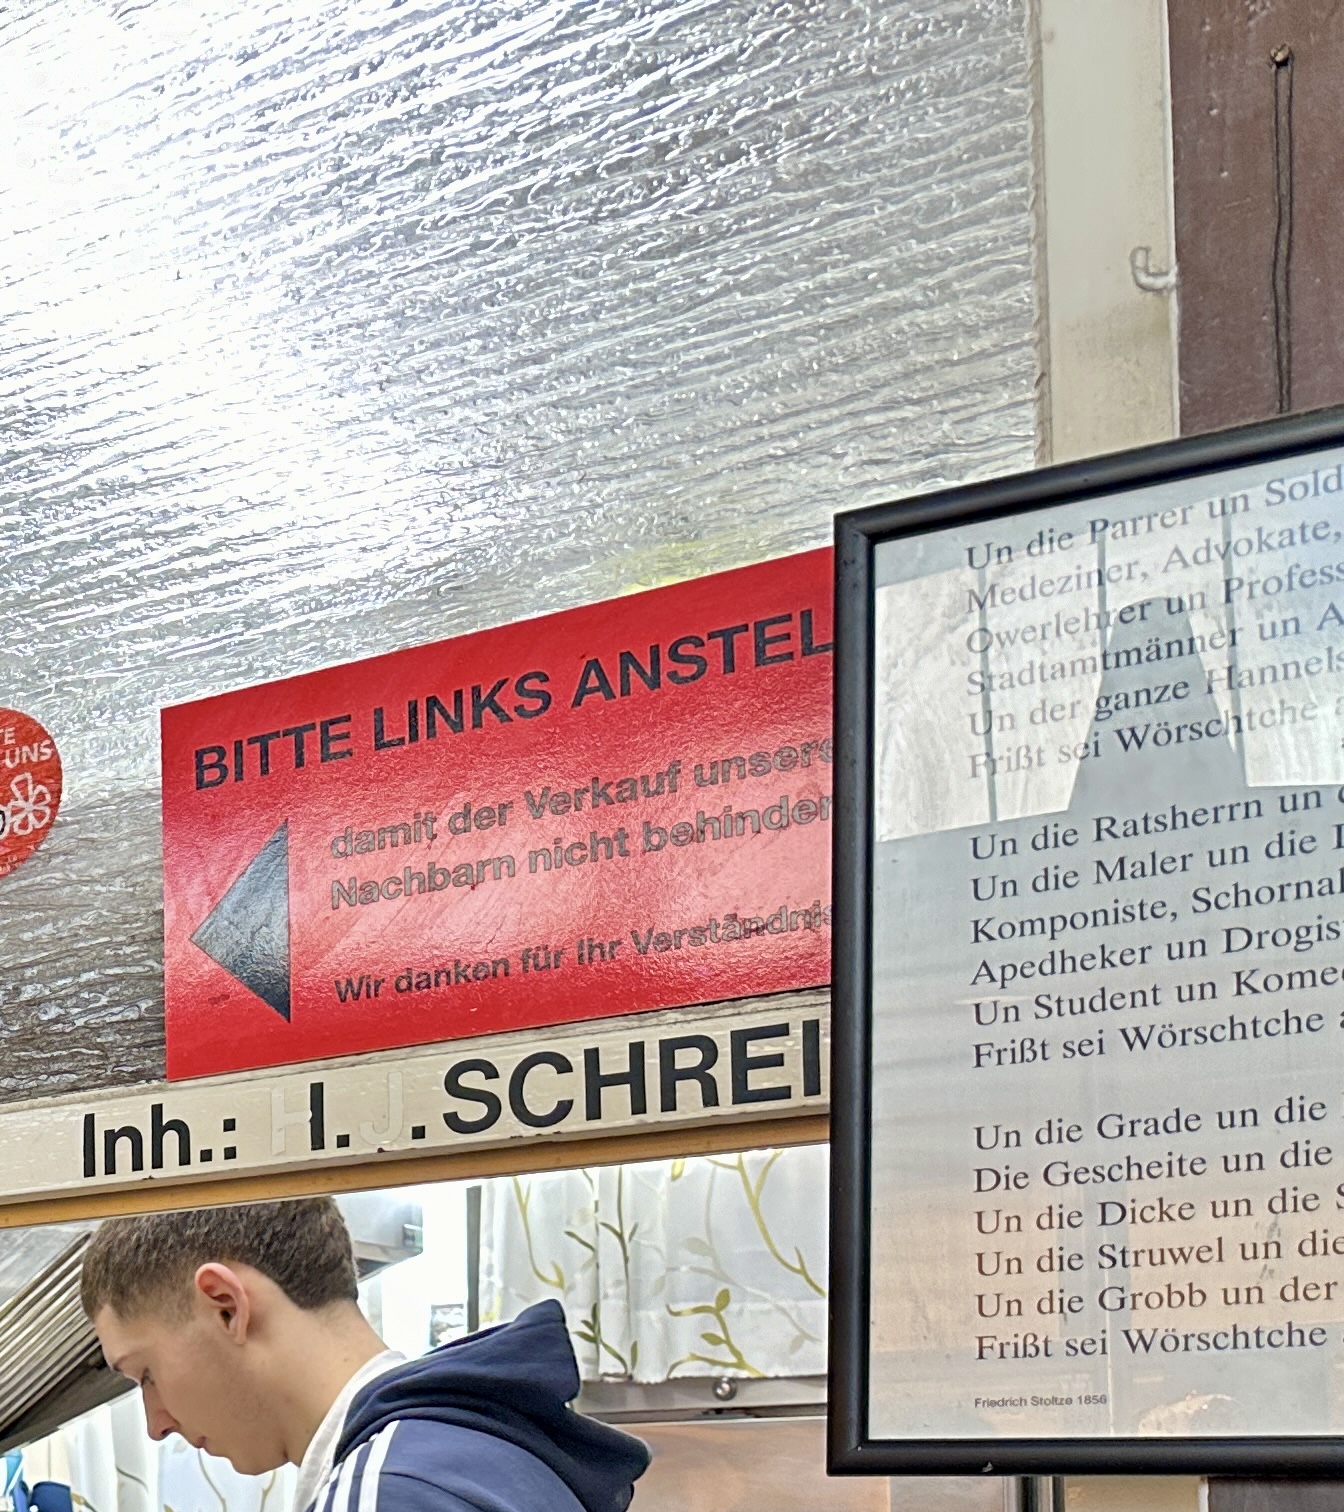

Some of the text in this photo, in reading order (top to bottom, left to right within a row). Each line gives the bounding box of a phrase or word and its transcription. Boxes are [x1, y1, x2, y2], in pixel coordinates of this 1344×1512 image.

[966, 464, 1344, 570] Un die Parrer un Sold
[965, 520, 1342, 614] Medeziner, Advokate,
[966, 600, 1152, 654] Owerlehrer
[1166, 591, 1206, 616] un
[966, 626, 1244, 697] Stadtamtmänner
[1259, 616, 1301, 641] un
[193, 608, 833, 792] BITTE LINKS ANSTEL
[968, 675, 1190, 738] Un der ganze
[4, 739, 54, 769] UNS
[968, 696, 1319, 780] Frißt sei Wörschtche
[331, 760, 681, 859] damit der Verkauf
[969, 788, 1323, 860] Un die Ratsherrn un
[331, 827, 630, 909] Nachbarn nicht
[971, 829, 1317, 902] Un die Maler un die
[970, 866, 1344, 945] Komponiste, Schornal
[334, 936, 620, 1003] Wir danken für Ihr
[969, 914, 1344, 989] Apedheker un Drogis
[973, 964, 1344, 1027] Un Student un Kome
[971, 1008, 1325, 1069] Frißt sei Wörschtche
[83, 1018, 822, 1178] Inh.: SCHREI
[973, 1094, 1328, 1151] Un die Grade un die
[973, 1139, 1333, 1194] Die Gescheite un die
[974, 1185, 1321, 1235] Un die Dicke un die
[975, 1230, 1344, 1277] Un die Struwel un die
[975, 1275, 1339, 1319] Un die Grobb un der
[975, 1320, 1328, 1362] Frißt sei Wörschtche
[974, 1396, 1027, 1409] Friedrich
[1030, 1395, 1073, 1407] Stoltze
